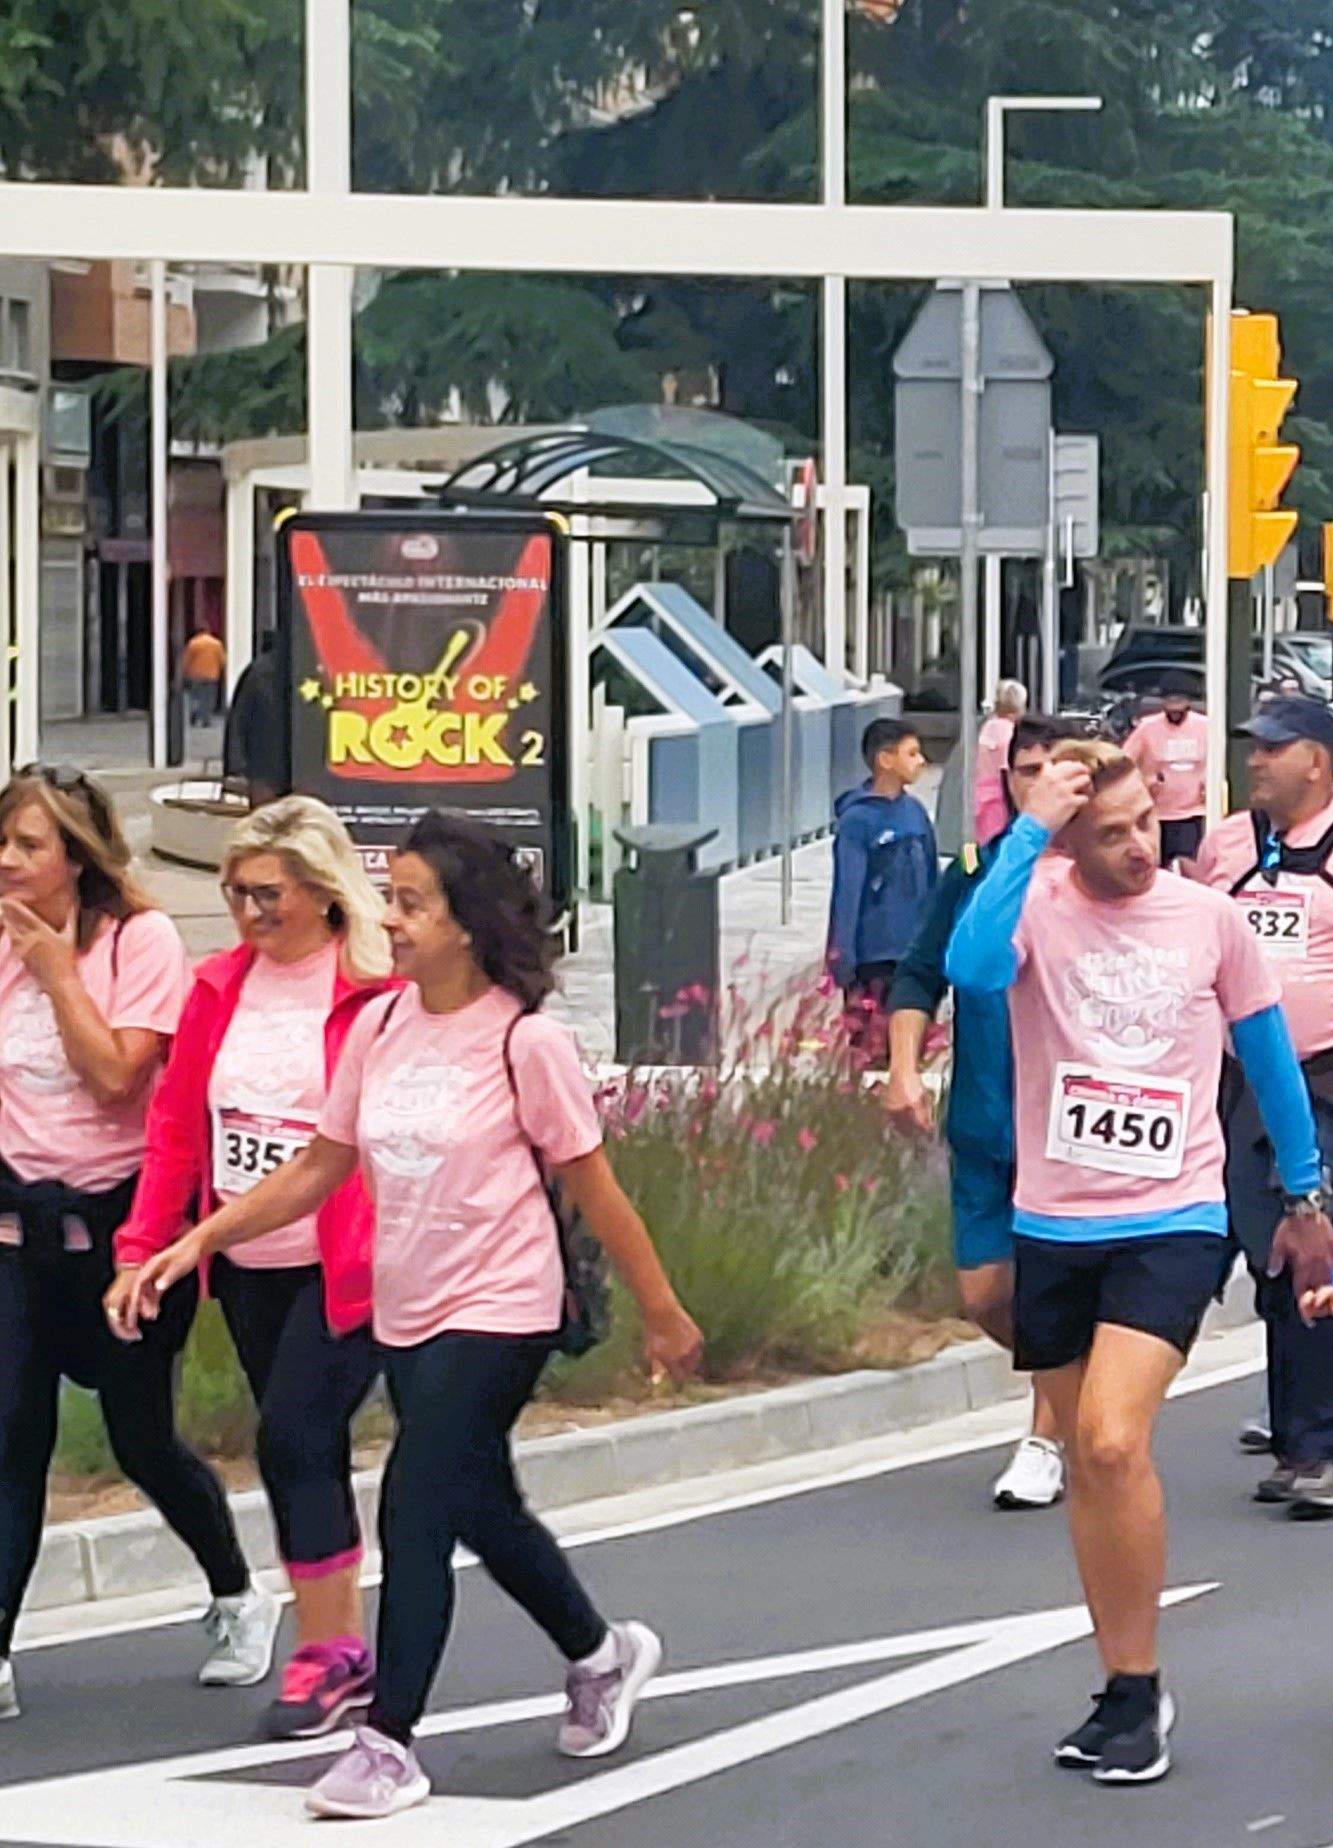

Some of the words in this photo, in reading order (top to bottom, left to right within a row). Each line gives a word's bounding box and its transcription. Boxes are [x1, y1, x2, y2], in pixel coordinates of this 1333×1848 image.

[335, 672, 459, 700] HISTORY
[468, 674, 507, 699] OF
[330, 710, 514, 768] ROCK
[520, 730, 545, 766] 2
[1067, 1104, 1173, 1152] 1450
